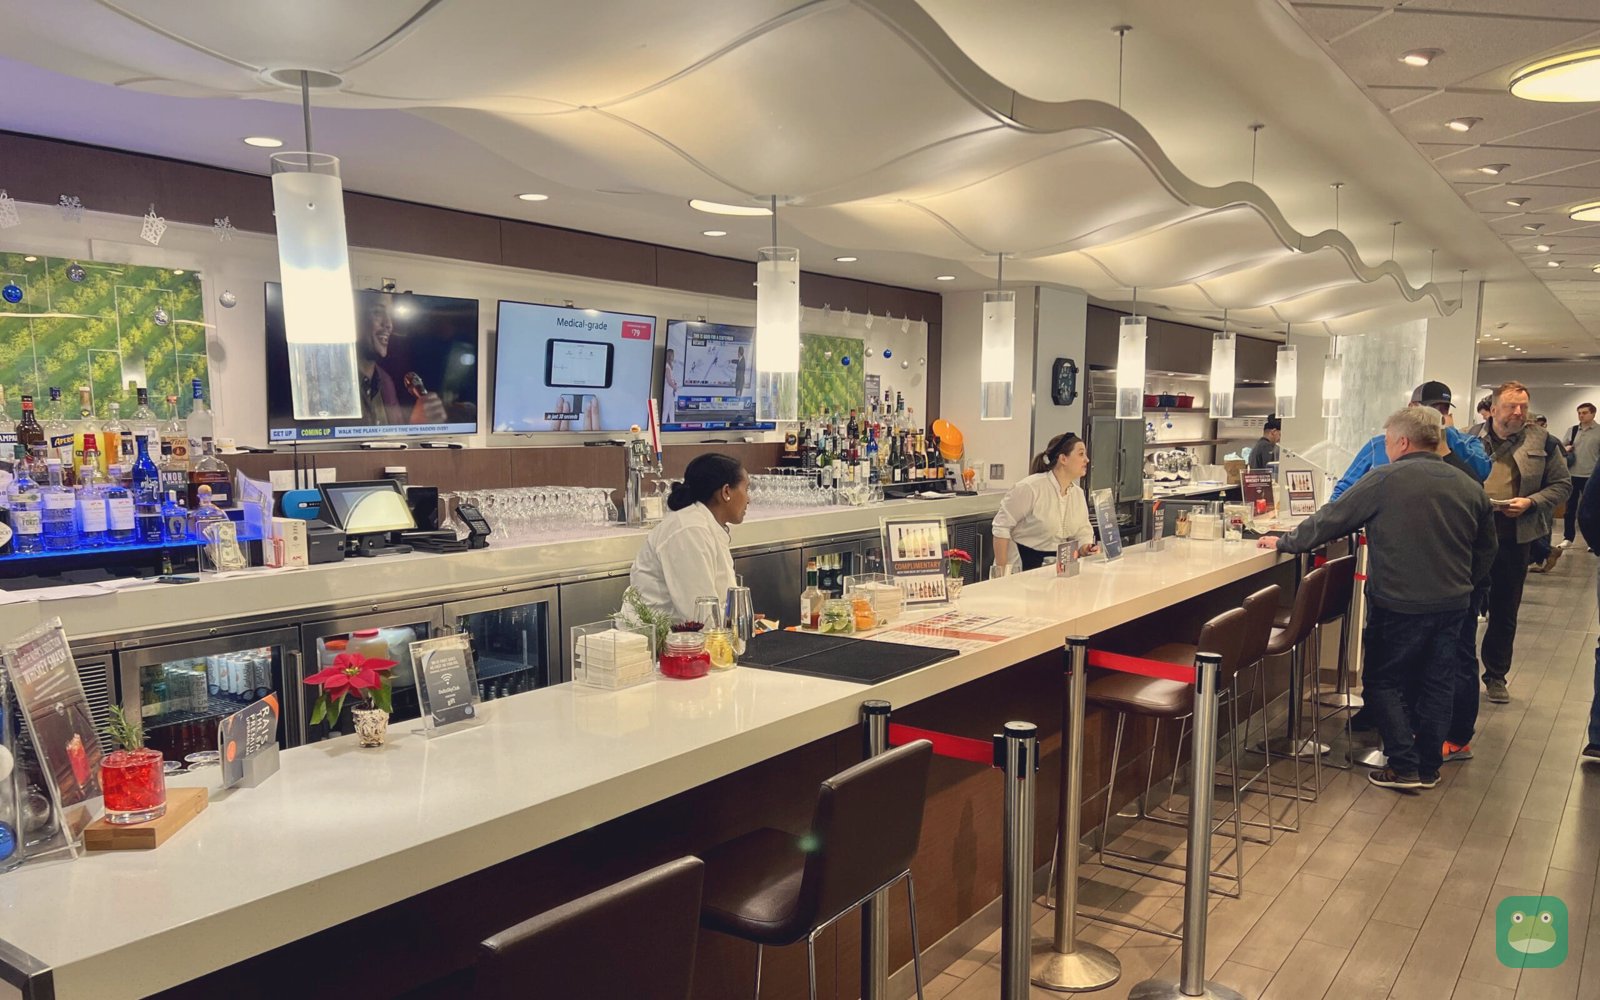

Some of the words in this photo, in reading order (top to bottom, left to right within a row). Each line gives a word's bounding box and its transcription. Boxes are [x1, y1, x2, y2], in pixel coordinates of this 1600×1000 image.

[556, 317, 608, 331] Medical-grade
[301, 428, 322, 436] COMING
[634, 443, 644, 451] IPA
[162, 472, 183, 481] KNOB
[261, 705, 270, 745] RAIS
